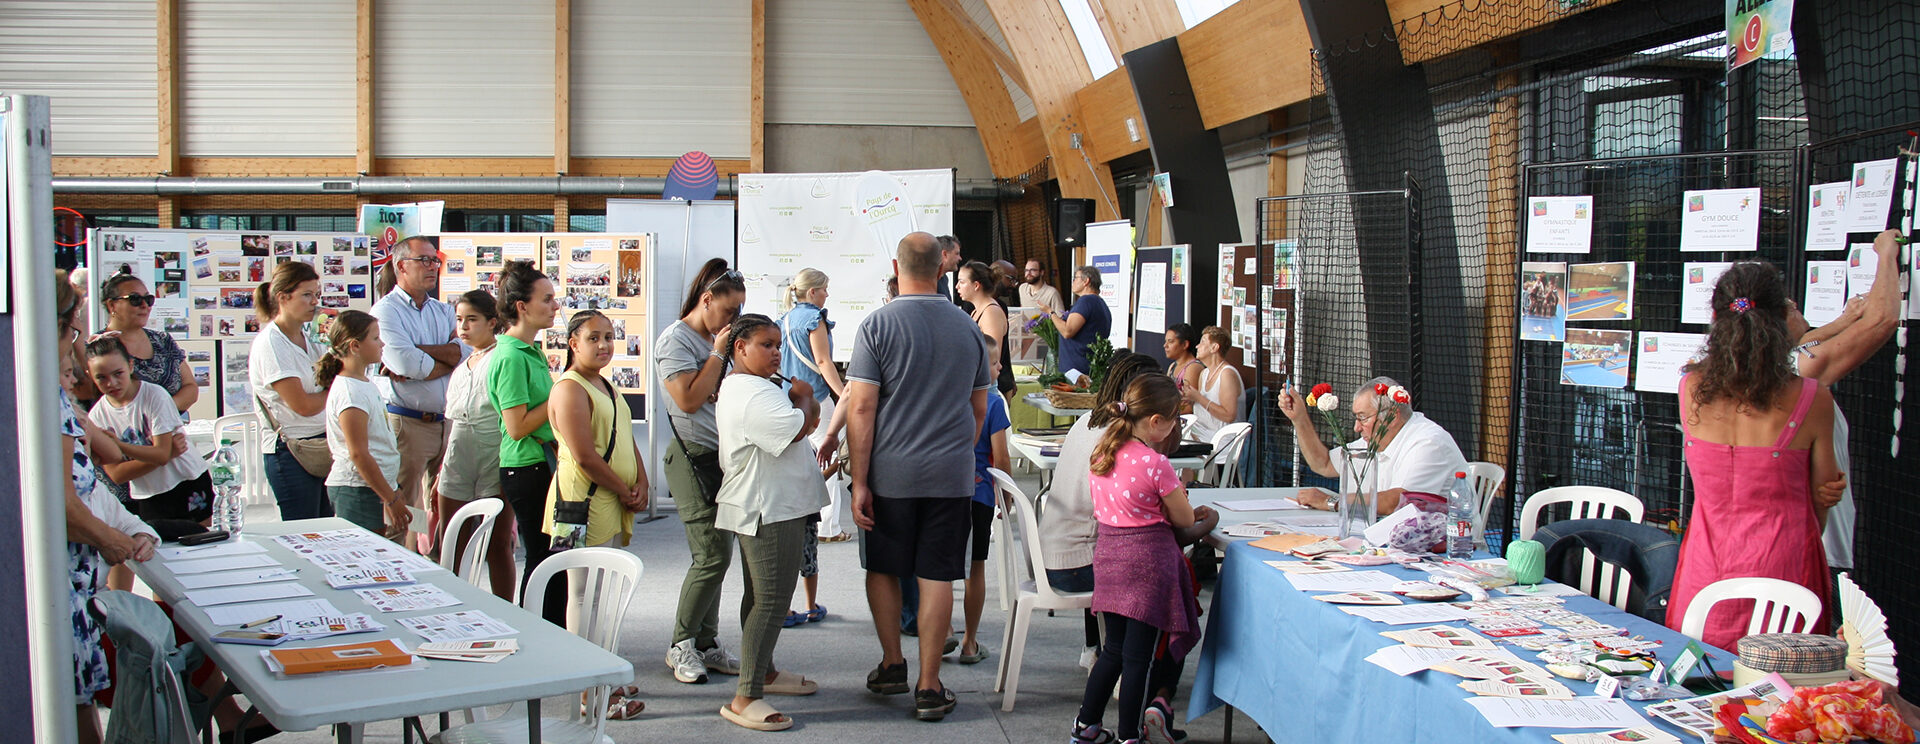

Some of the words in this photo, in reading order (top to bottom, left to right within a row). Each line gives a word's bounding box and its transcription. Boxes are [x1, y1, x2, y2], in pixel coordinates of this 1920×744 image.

[1751, 23, 1757, 42] C
[866, 196, 882, 206] Pays
[883, 191, 892, 199] de
[379, 208, 404, 224] ÎLOT
[869, 204, 897, 219] l'Ourcq
[388, 231, 393, 240] 6
